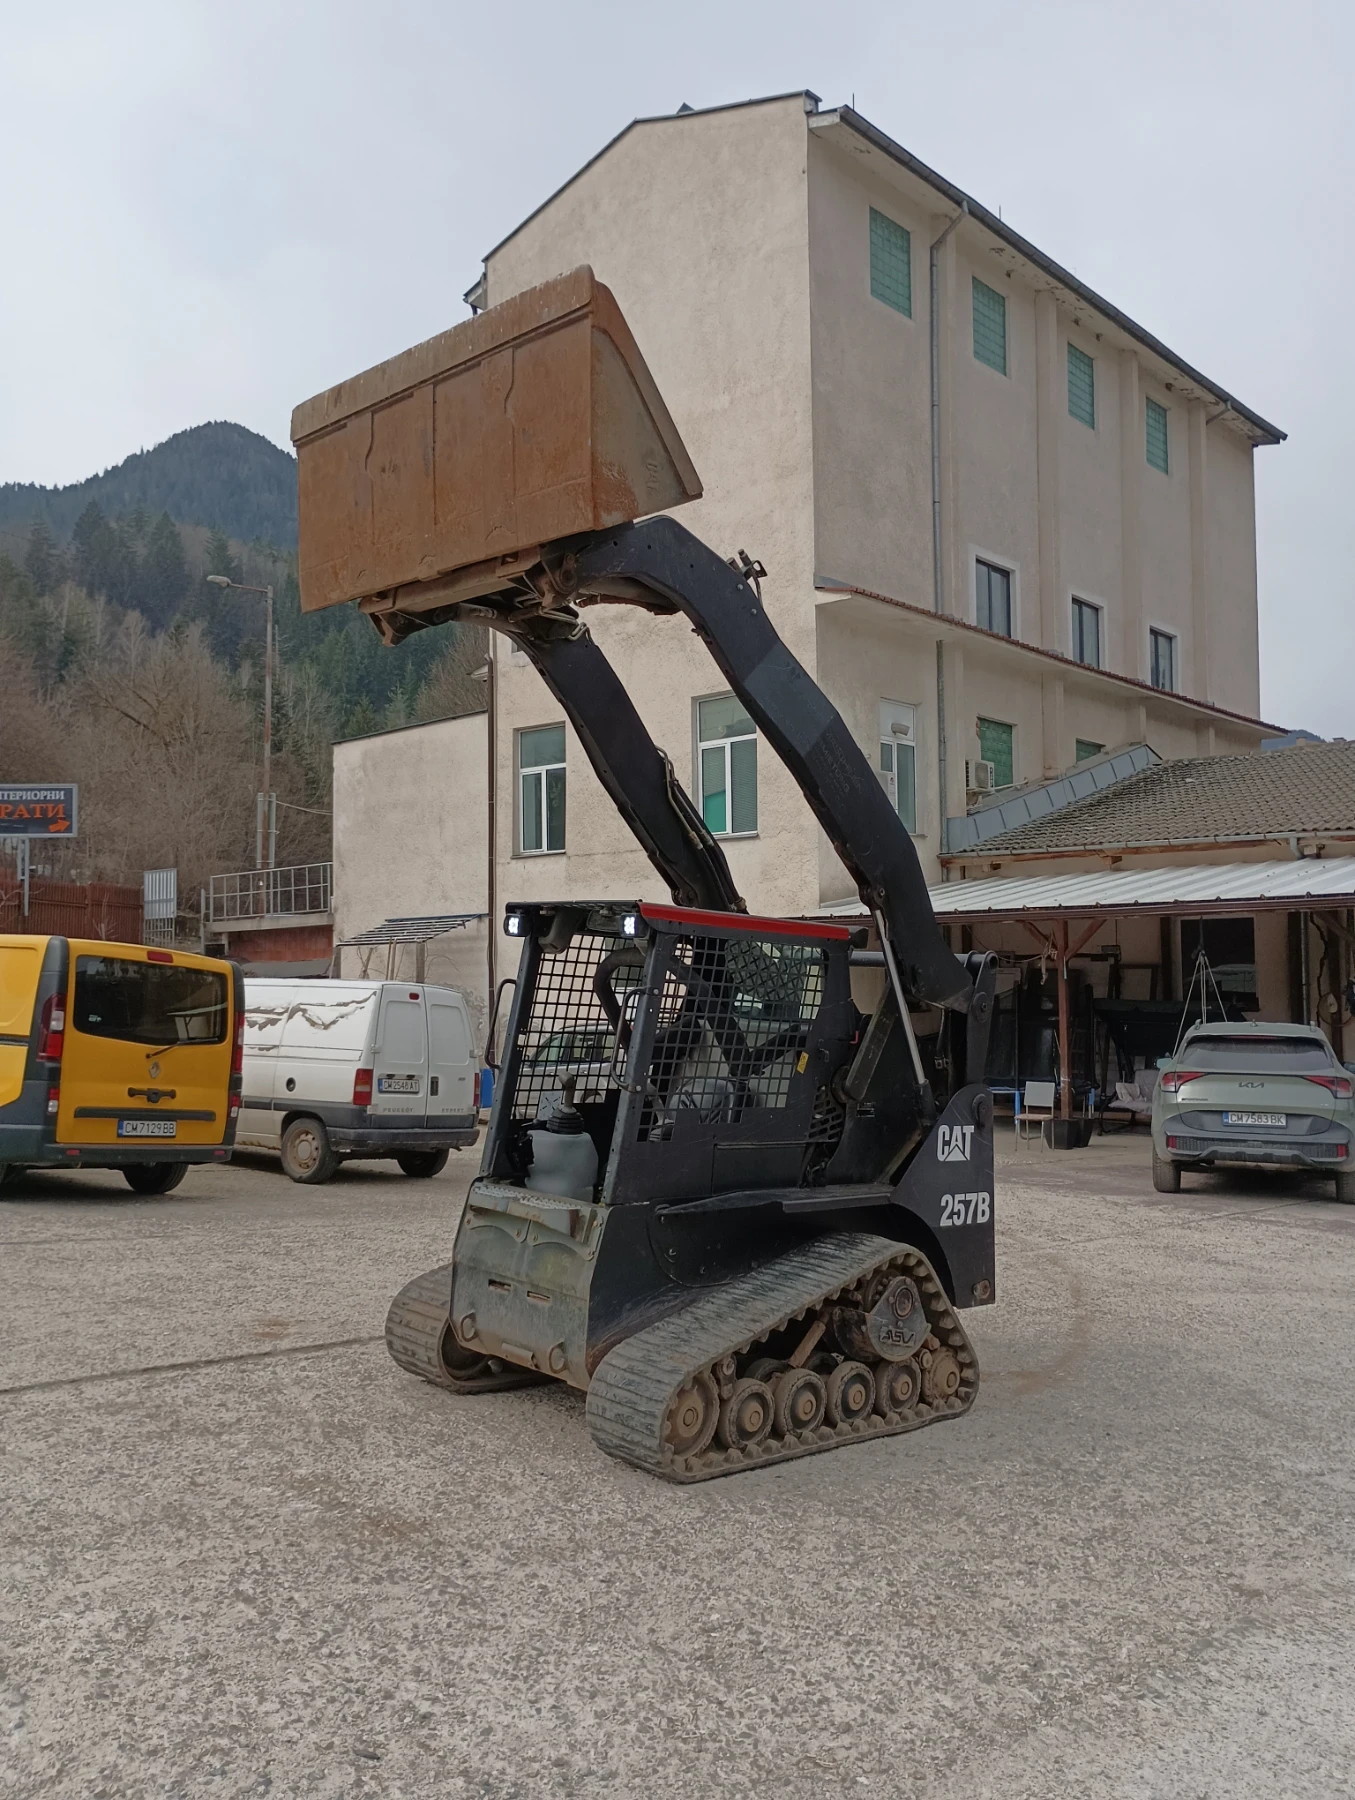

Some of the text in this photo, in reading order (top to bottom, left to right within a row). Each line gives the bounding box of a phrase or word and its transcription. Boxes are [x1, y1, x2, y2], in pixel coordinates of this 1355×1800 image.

[0, 803, 66, 819] РАТИ
[937, 1124, 975, 1162] CAT
[940, 1191, 991, 1227] 257B
